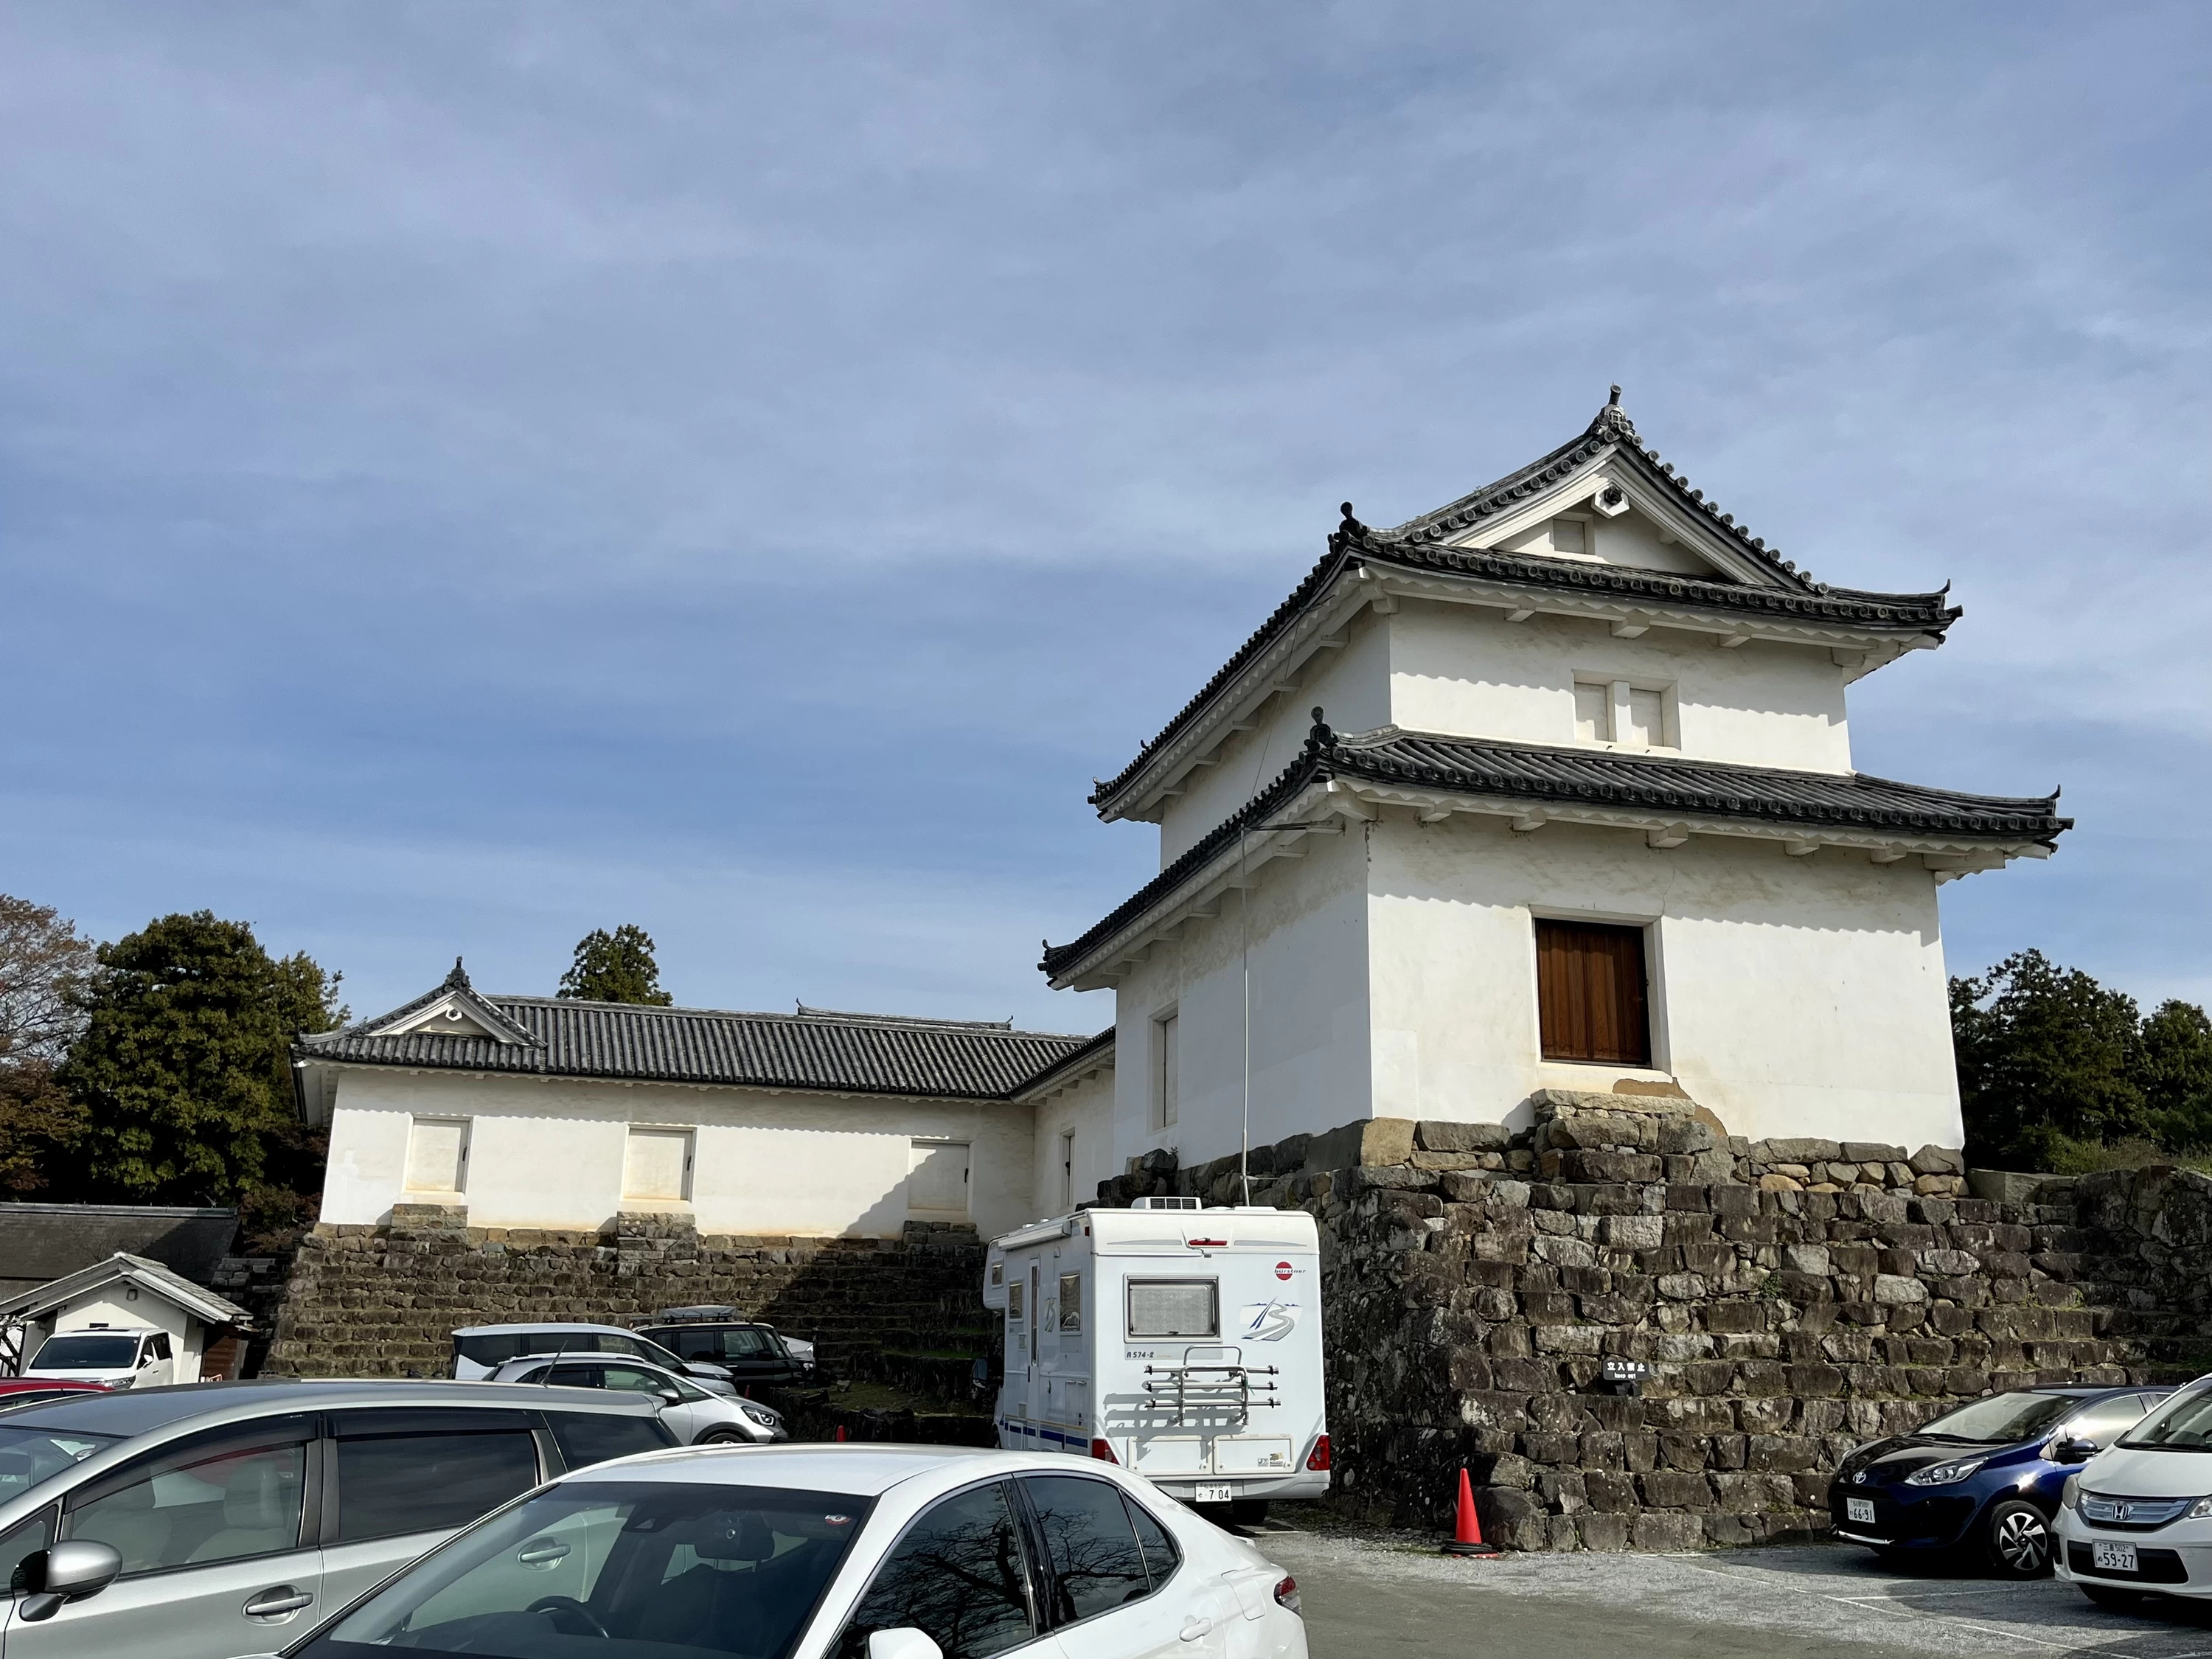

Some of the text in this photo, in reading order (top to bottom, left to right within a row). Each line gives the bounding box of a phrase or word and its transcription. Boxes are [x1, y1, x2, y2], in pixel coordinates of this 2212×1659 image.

[1607, 1361, 1646, 1372] 立入禁止
[2103, 1551, 2135, 1568] 59-27
